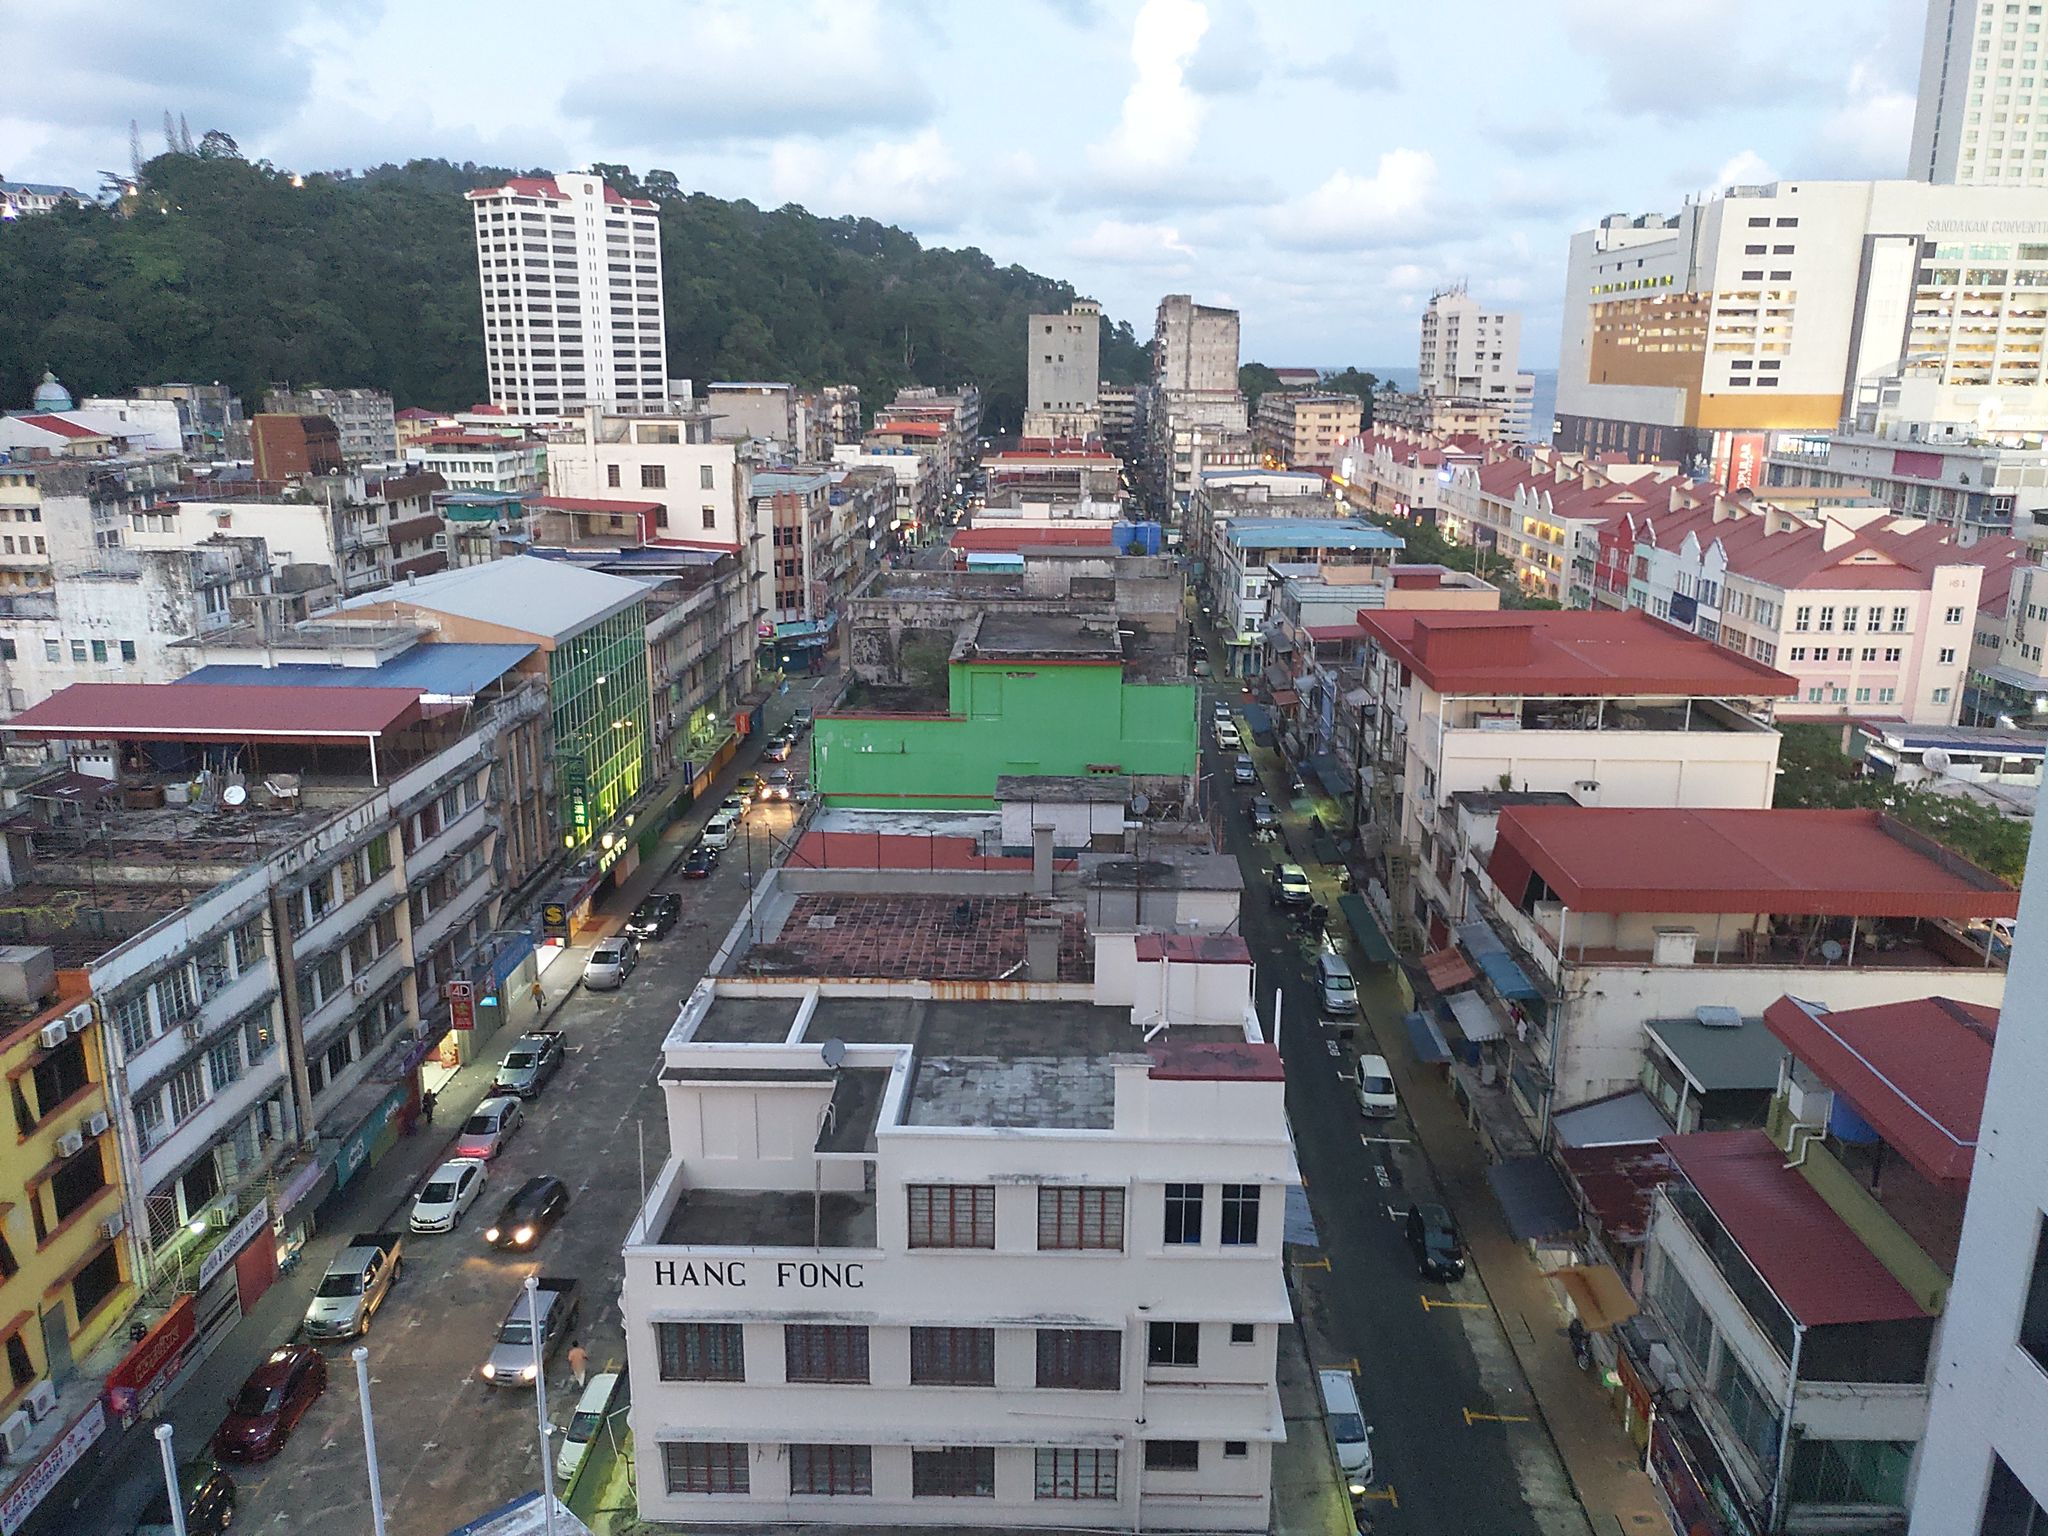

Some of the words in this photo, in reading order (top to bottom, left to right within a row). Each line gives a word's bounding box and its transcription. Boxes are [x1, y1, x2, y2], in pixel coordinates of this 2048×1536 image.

[1926, 219, 1989, 234] SANDAKAN
[452, 984, 470, 997] 4D
[655, 1261, 746, 1287] HANG
[777, 1262, 864, 1289] FONG
[2, 1444, 63, 1515] FARMASI
